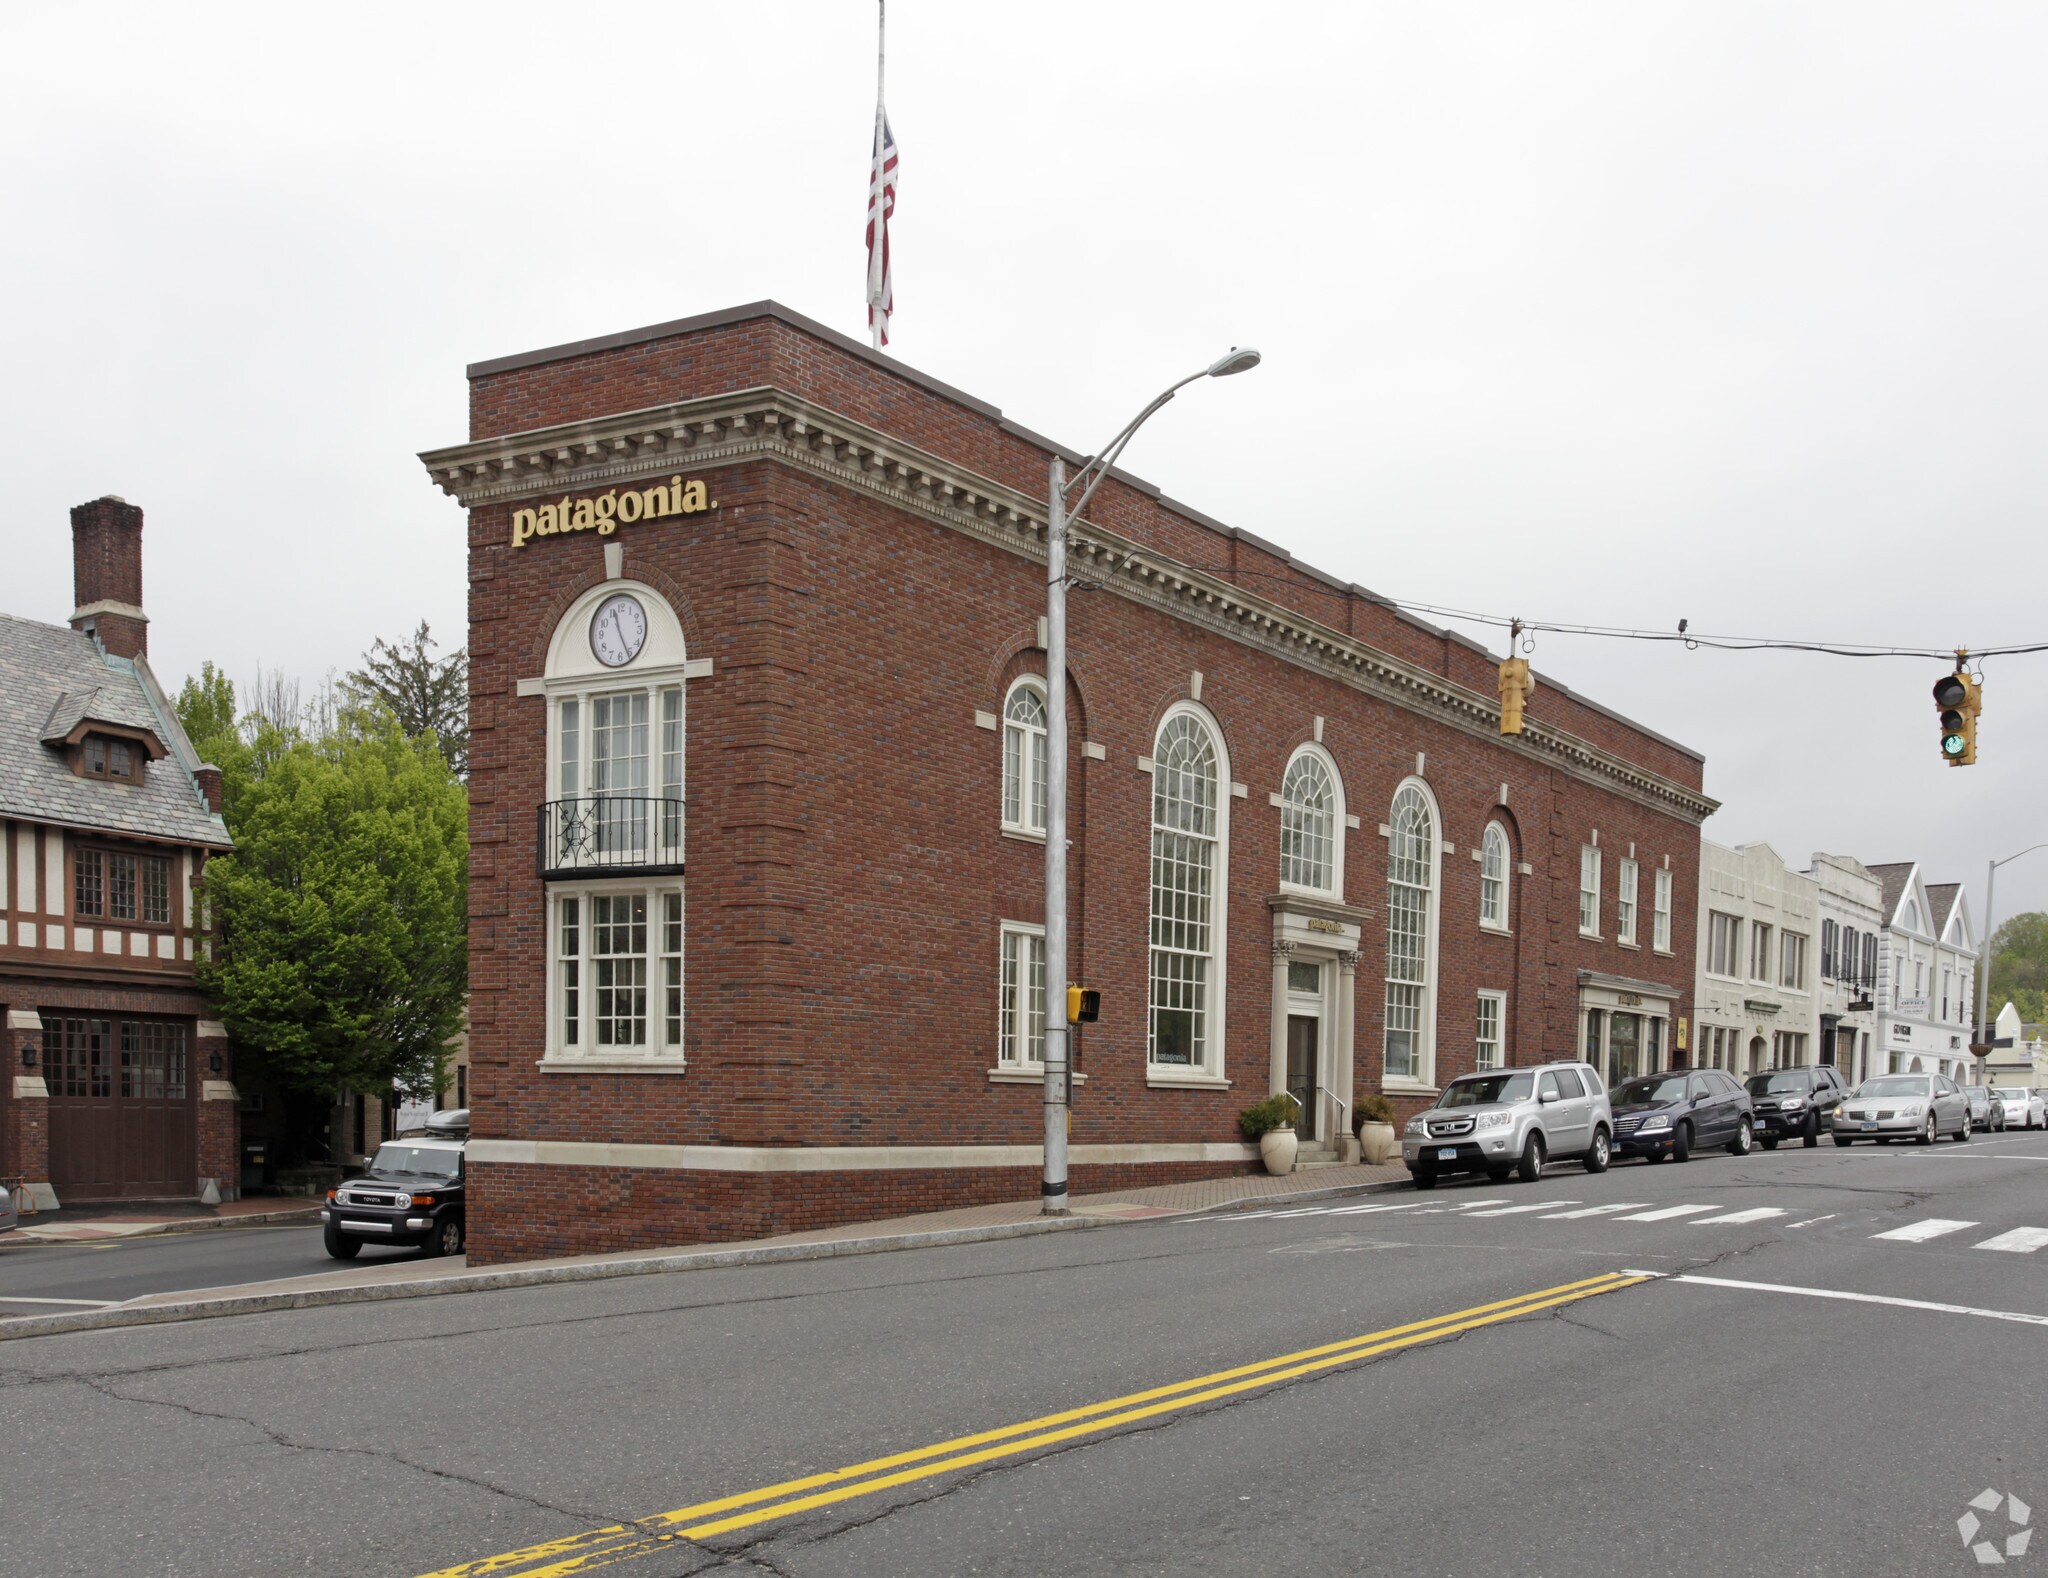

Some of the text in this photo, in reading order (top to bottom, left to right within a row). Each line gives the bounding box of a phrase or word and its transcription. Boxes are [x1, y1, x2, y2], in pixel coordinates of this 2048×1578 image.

[618, 602, 625, 613] 12
[601, 618, 608, 628] 10
[634, 613, 639, 623] 2
[599, 630, 604, 639] 9
[637, 625, 642, 634] 3
[601, 643, 607, 652] 8
[634, 638, 640, 647] 4
[609, 650, 614, 660] 7
[618, 651, 623, 661] 6
